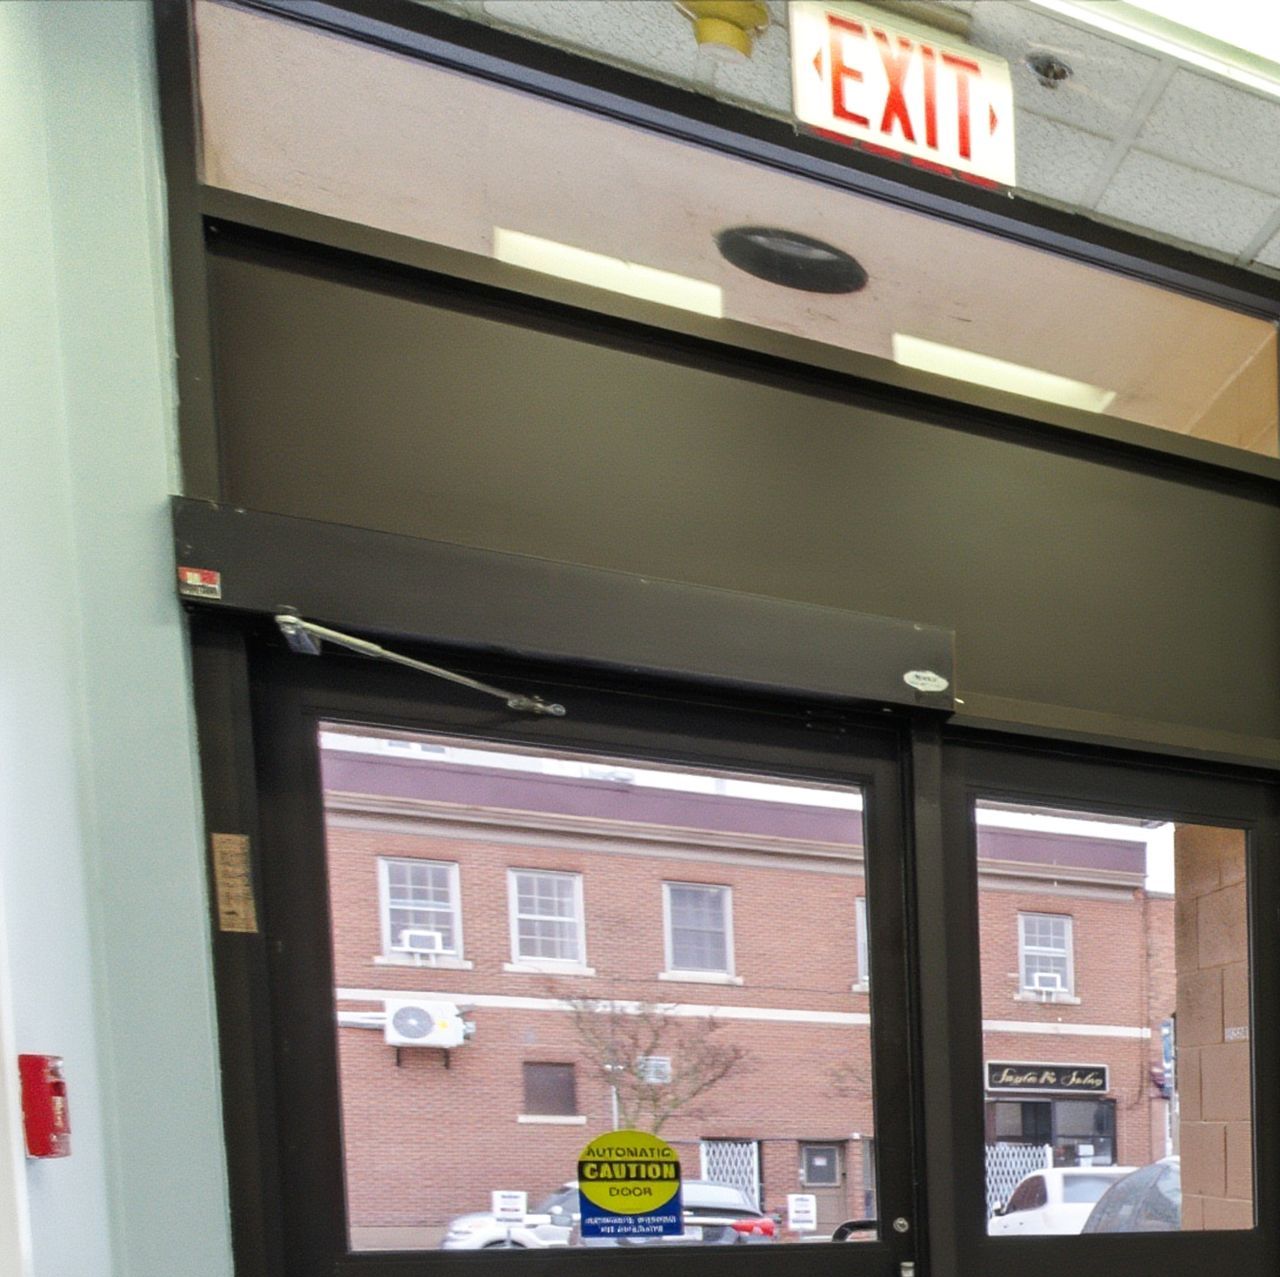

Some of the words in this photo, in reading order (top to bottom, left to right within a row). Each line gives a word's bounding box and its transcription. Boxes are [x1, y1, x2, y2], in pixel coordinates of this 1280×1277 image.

[827, 13, 981, 161] EXIT
[586, 1146, 672, 1158] AUTOMATIC
[583, 1162, 676, 1180] CAUTION
[608, 1186, 653, 1197] DOOR
